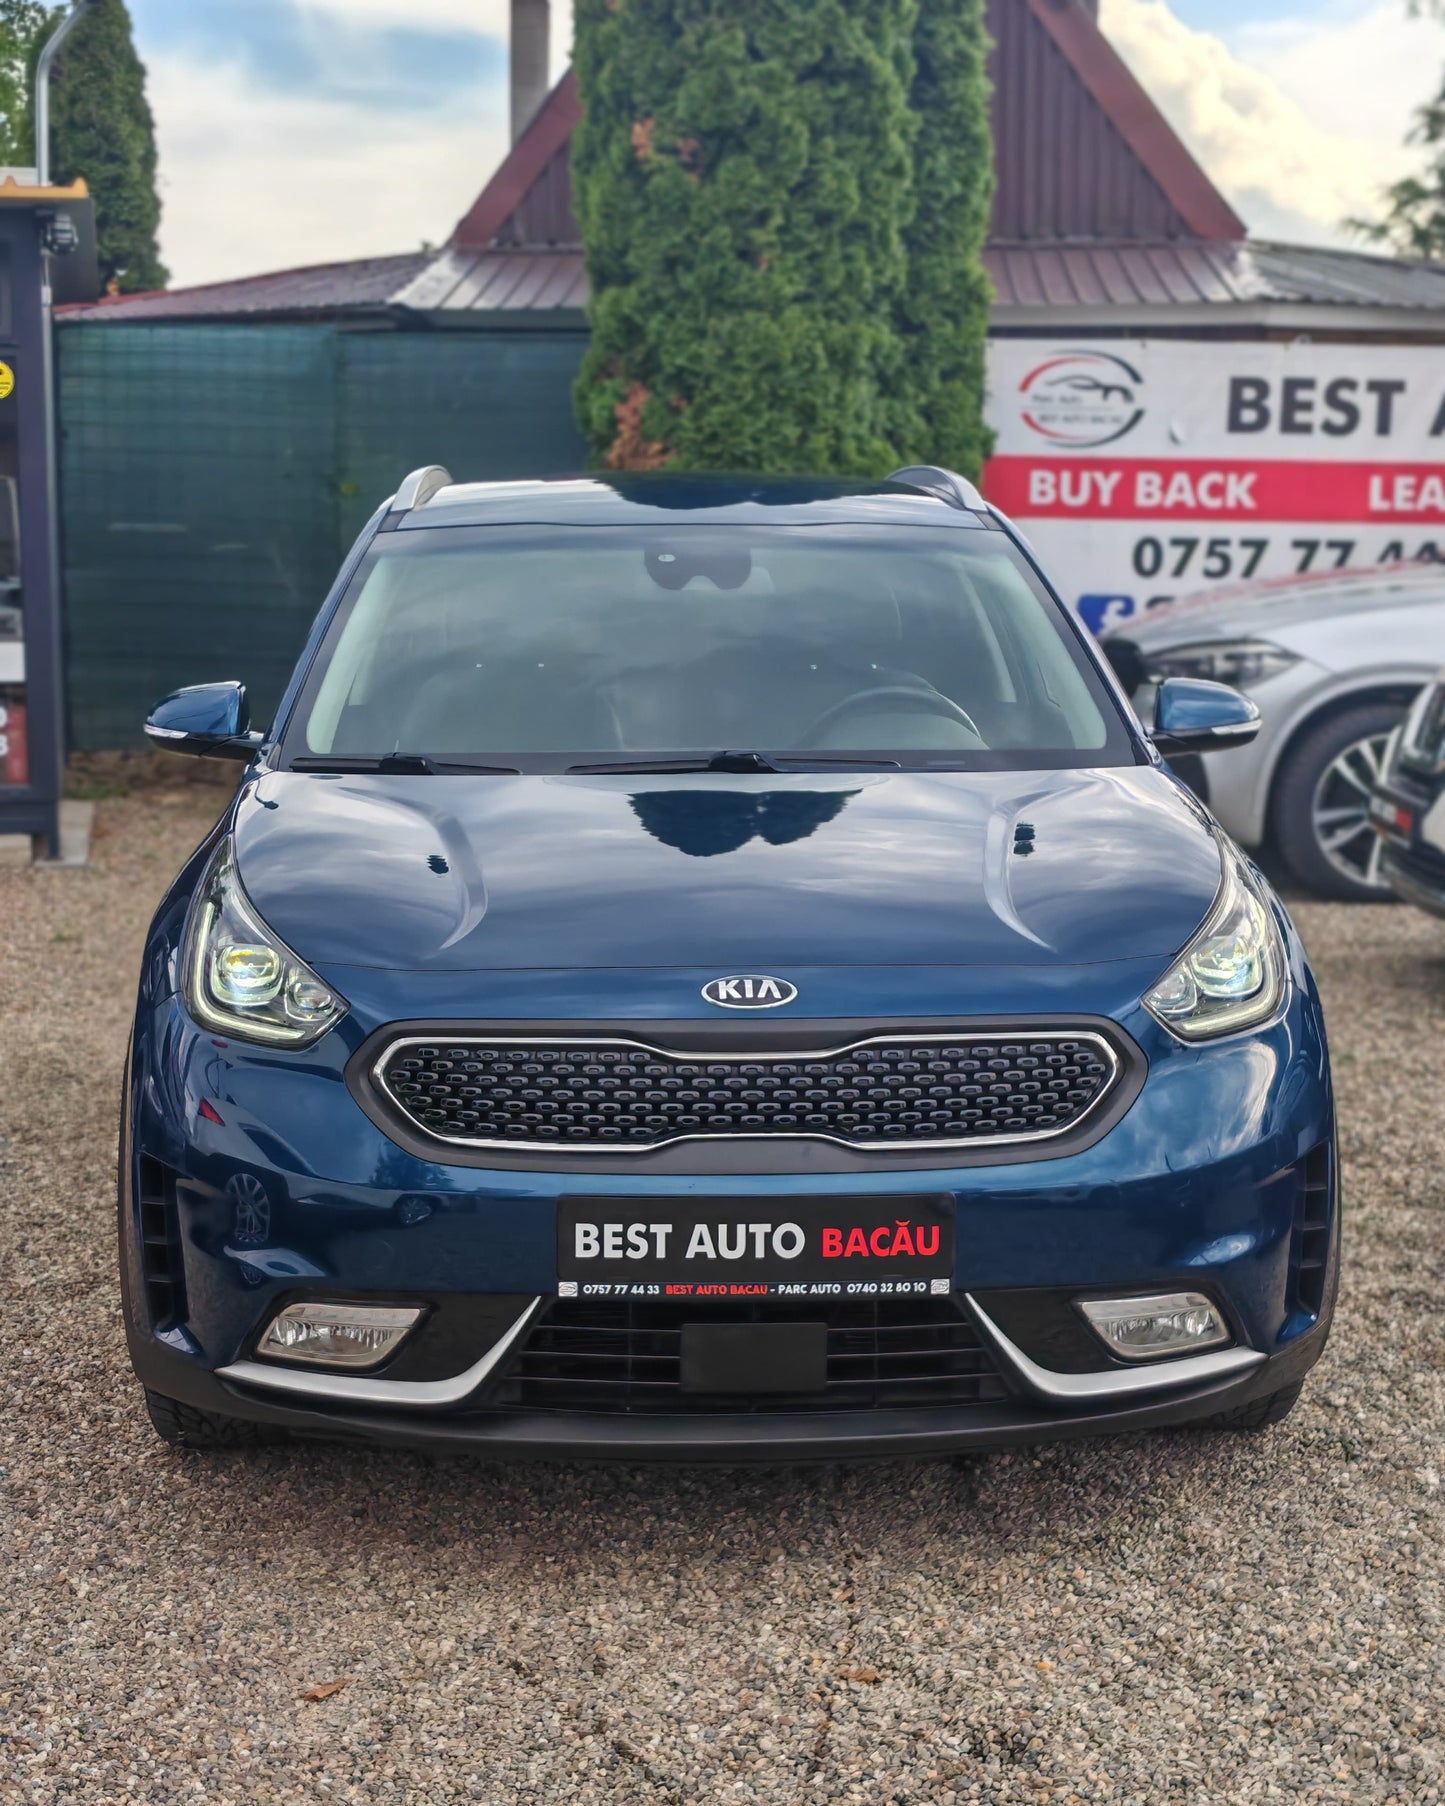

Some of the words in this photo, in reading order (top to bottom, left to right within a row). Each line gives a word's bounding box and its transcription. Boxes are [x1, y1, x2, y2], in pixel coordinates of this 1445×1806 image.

[1226, 376, 1406, 437] BEST
[1029, 469, 1122, 507] BUY
[1134, 472, 1257, 510] BACK
[1368, 474, 1445, 512] LEA
[1132, 537, 1269, 579] 0757
[717, 979, 782, 1000] KIA
[575, 1223, 672, 1259] BEST
[685, 1222, 806, 1260] AUTO
[821, 1219, 940, 1258] BACĂU
[582, 1284, 612, 1295] 0757
[614, 1284, 629, 1295] 77
[630, 1284, 645, 1295] 44
[646, 1284, 660, 1295] 33
[665, 1284, 693, 1295] BEST
[696, 1284, 727, 1295] AUTO
[730, 1284, 768, 1295] BACAU
[778, 1284, 808, 1295] PARC
[810, 1283, 841, 1294] AUTO
[847, 1283, 877, 1293] 0740
[880, 1282, 893, 1293] 32
[896, 1282, 911, 1293] 80
[913, 1281, 927, 1292] 10
